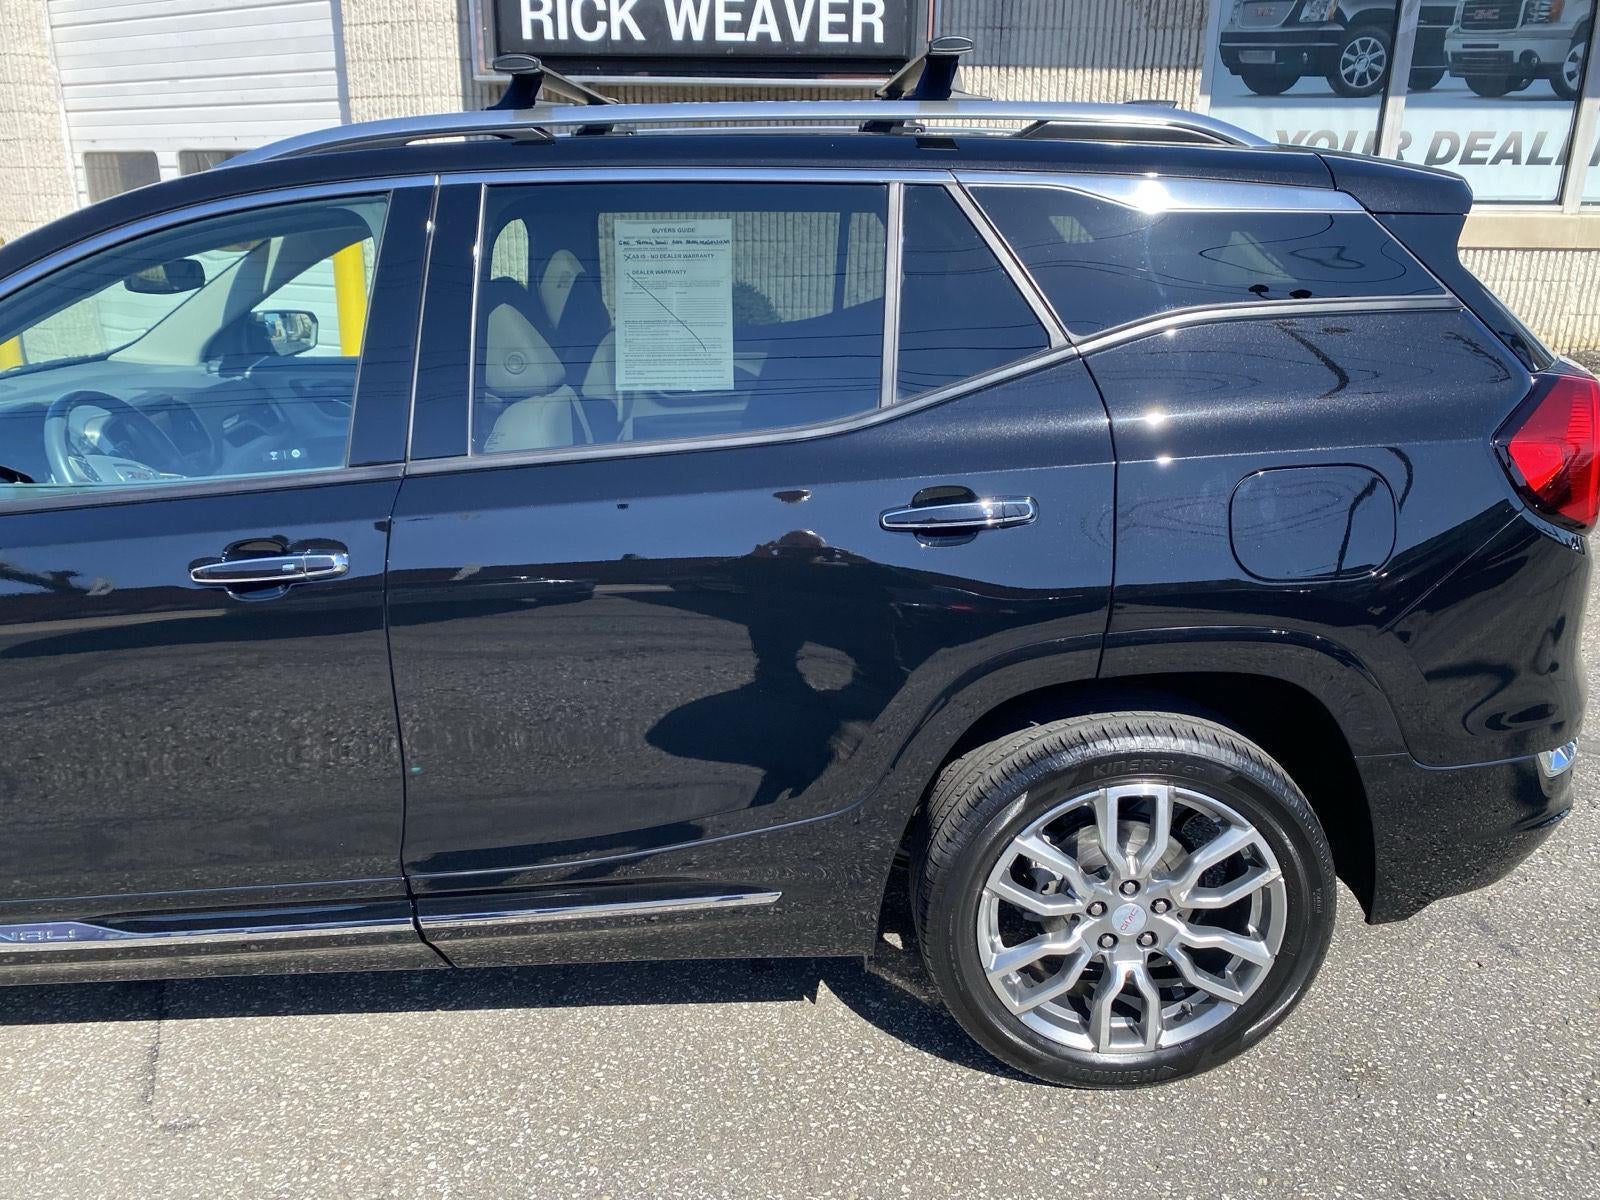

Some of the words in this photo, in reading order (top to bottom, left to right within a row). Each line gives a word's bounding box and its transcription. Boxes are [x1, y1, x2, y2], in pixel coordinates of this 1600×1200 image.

[520, 0, 646, 42] RICK
[664, 0, 885, 43] WEAVER
[1473, 8, 1500, 20] GMC
[1424, 131, 1600, 167] DEAL
[1120, 905, 1140, 931] GMC
